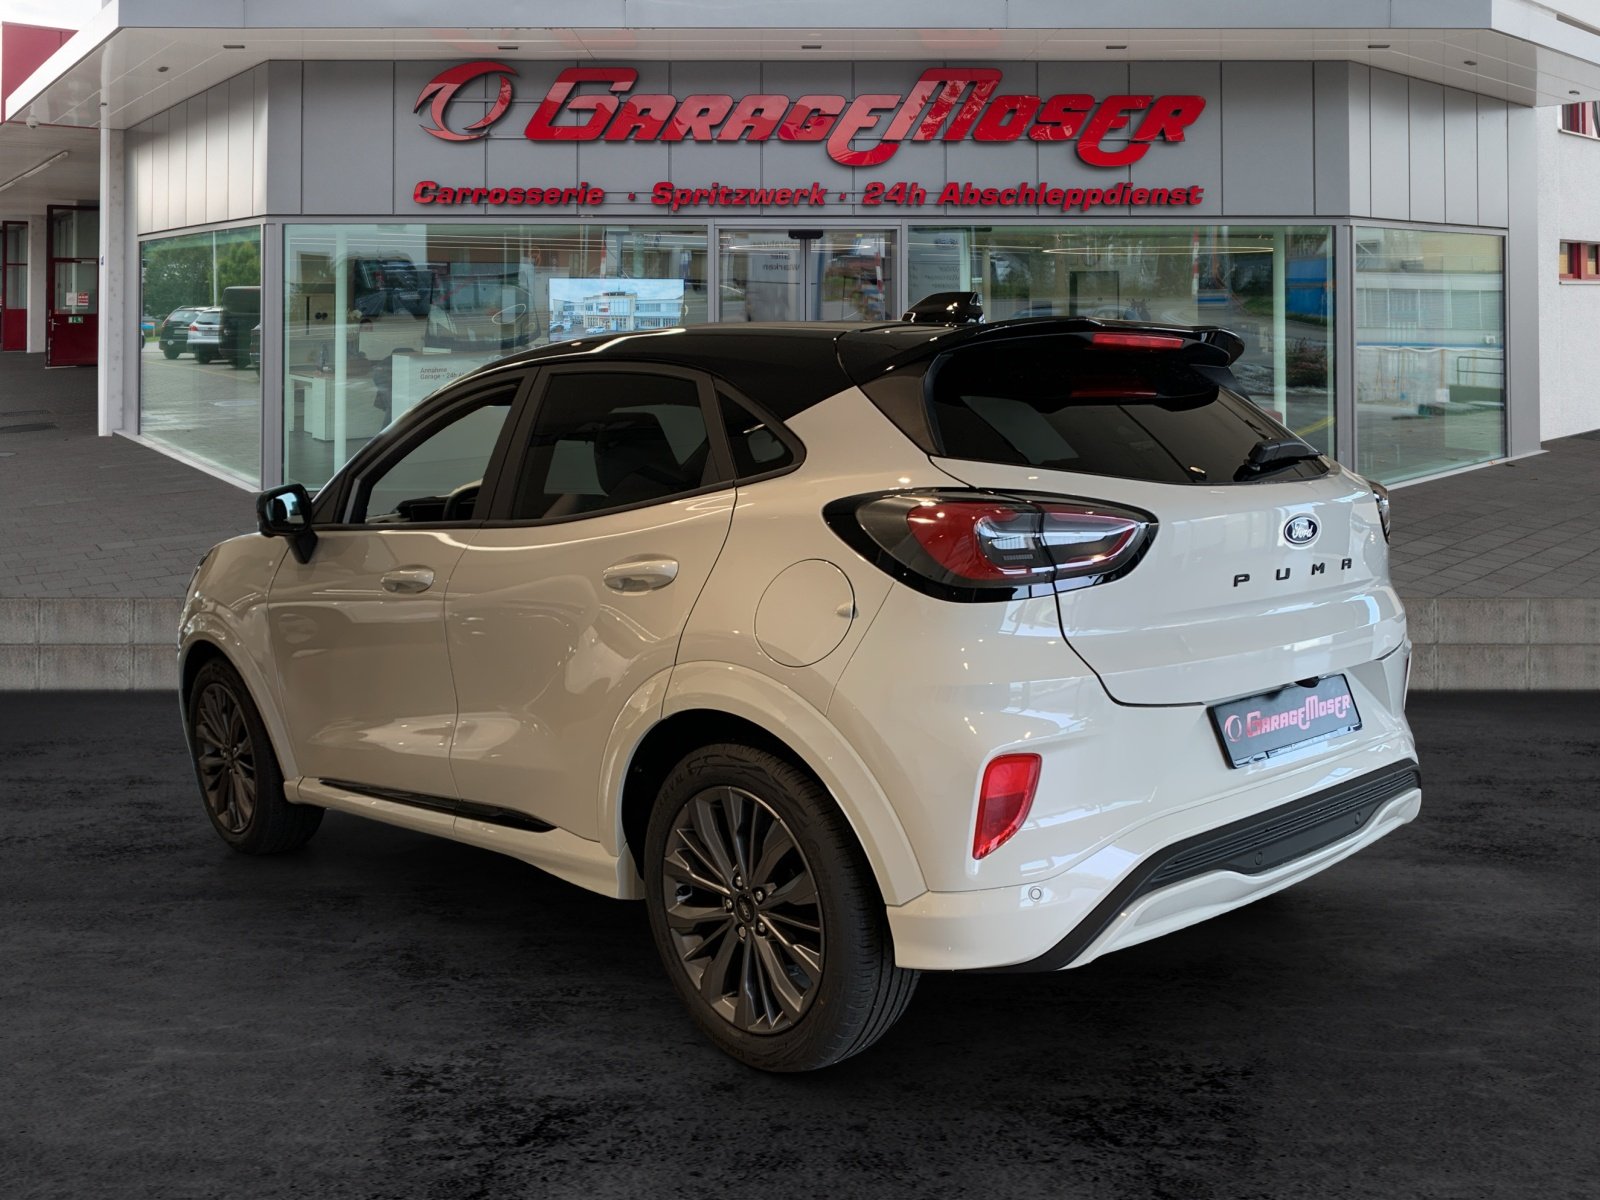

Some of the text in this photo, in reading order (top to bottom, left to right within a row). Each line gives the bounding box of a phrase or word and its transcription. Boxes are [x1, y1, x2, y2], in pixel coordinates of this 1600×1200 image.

[413, 181, 1205, 212] Carrosserie Spritzwerk 24h Abschleppdienst
[1289, 519, 1315, 540] Ford
[1233, 558, 1352, 587] PUMA
